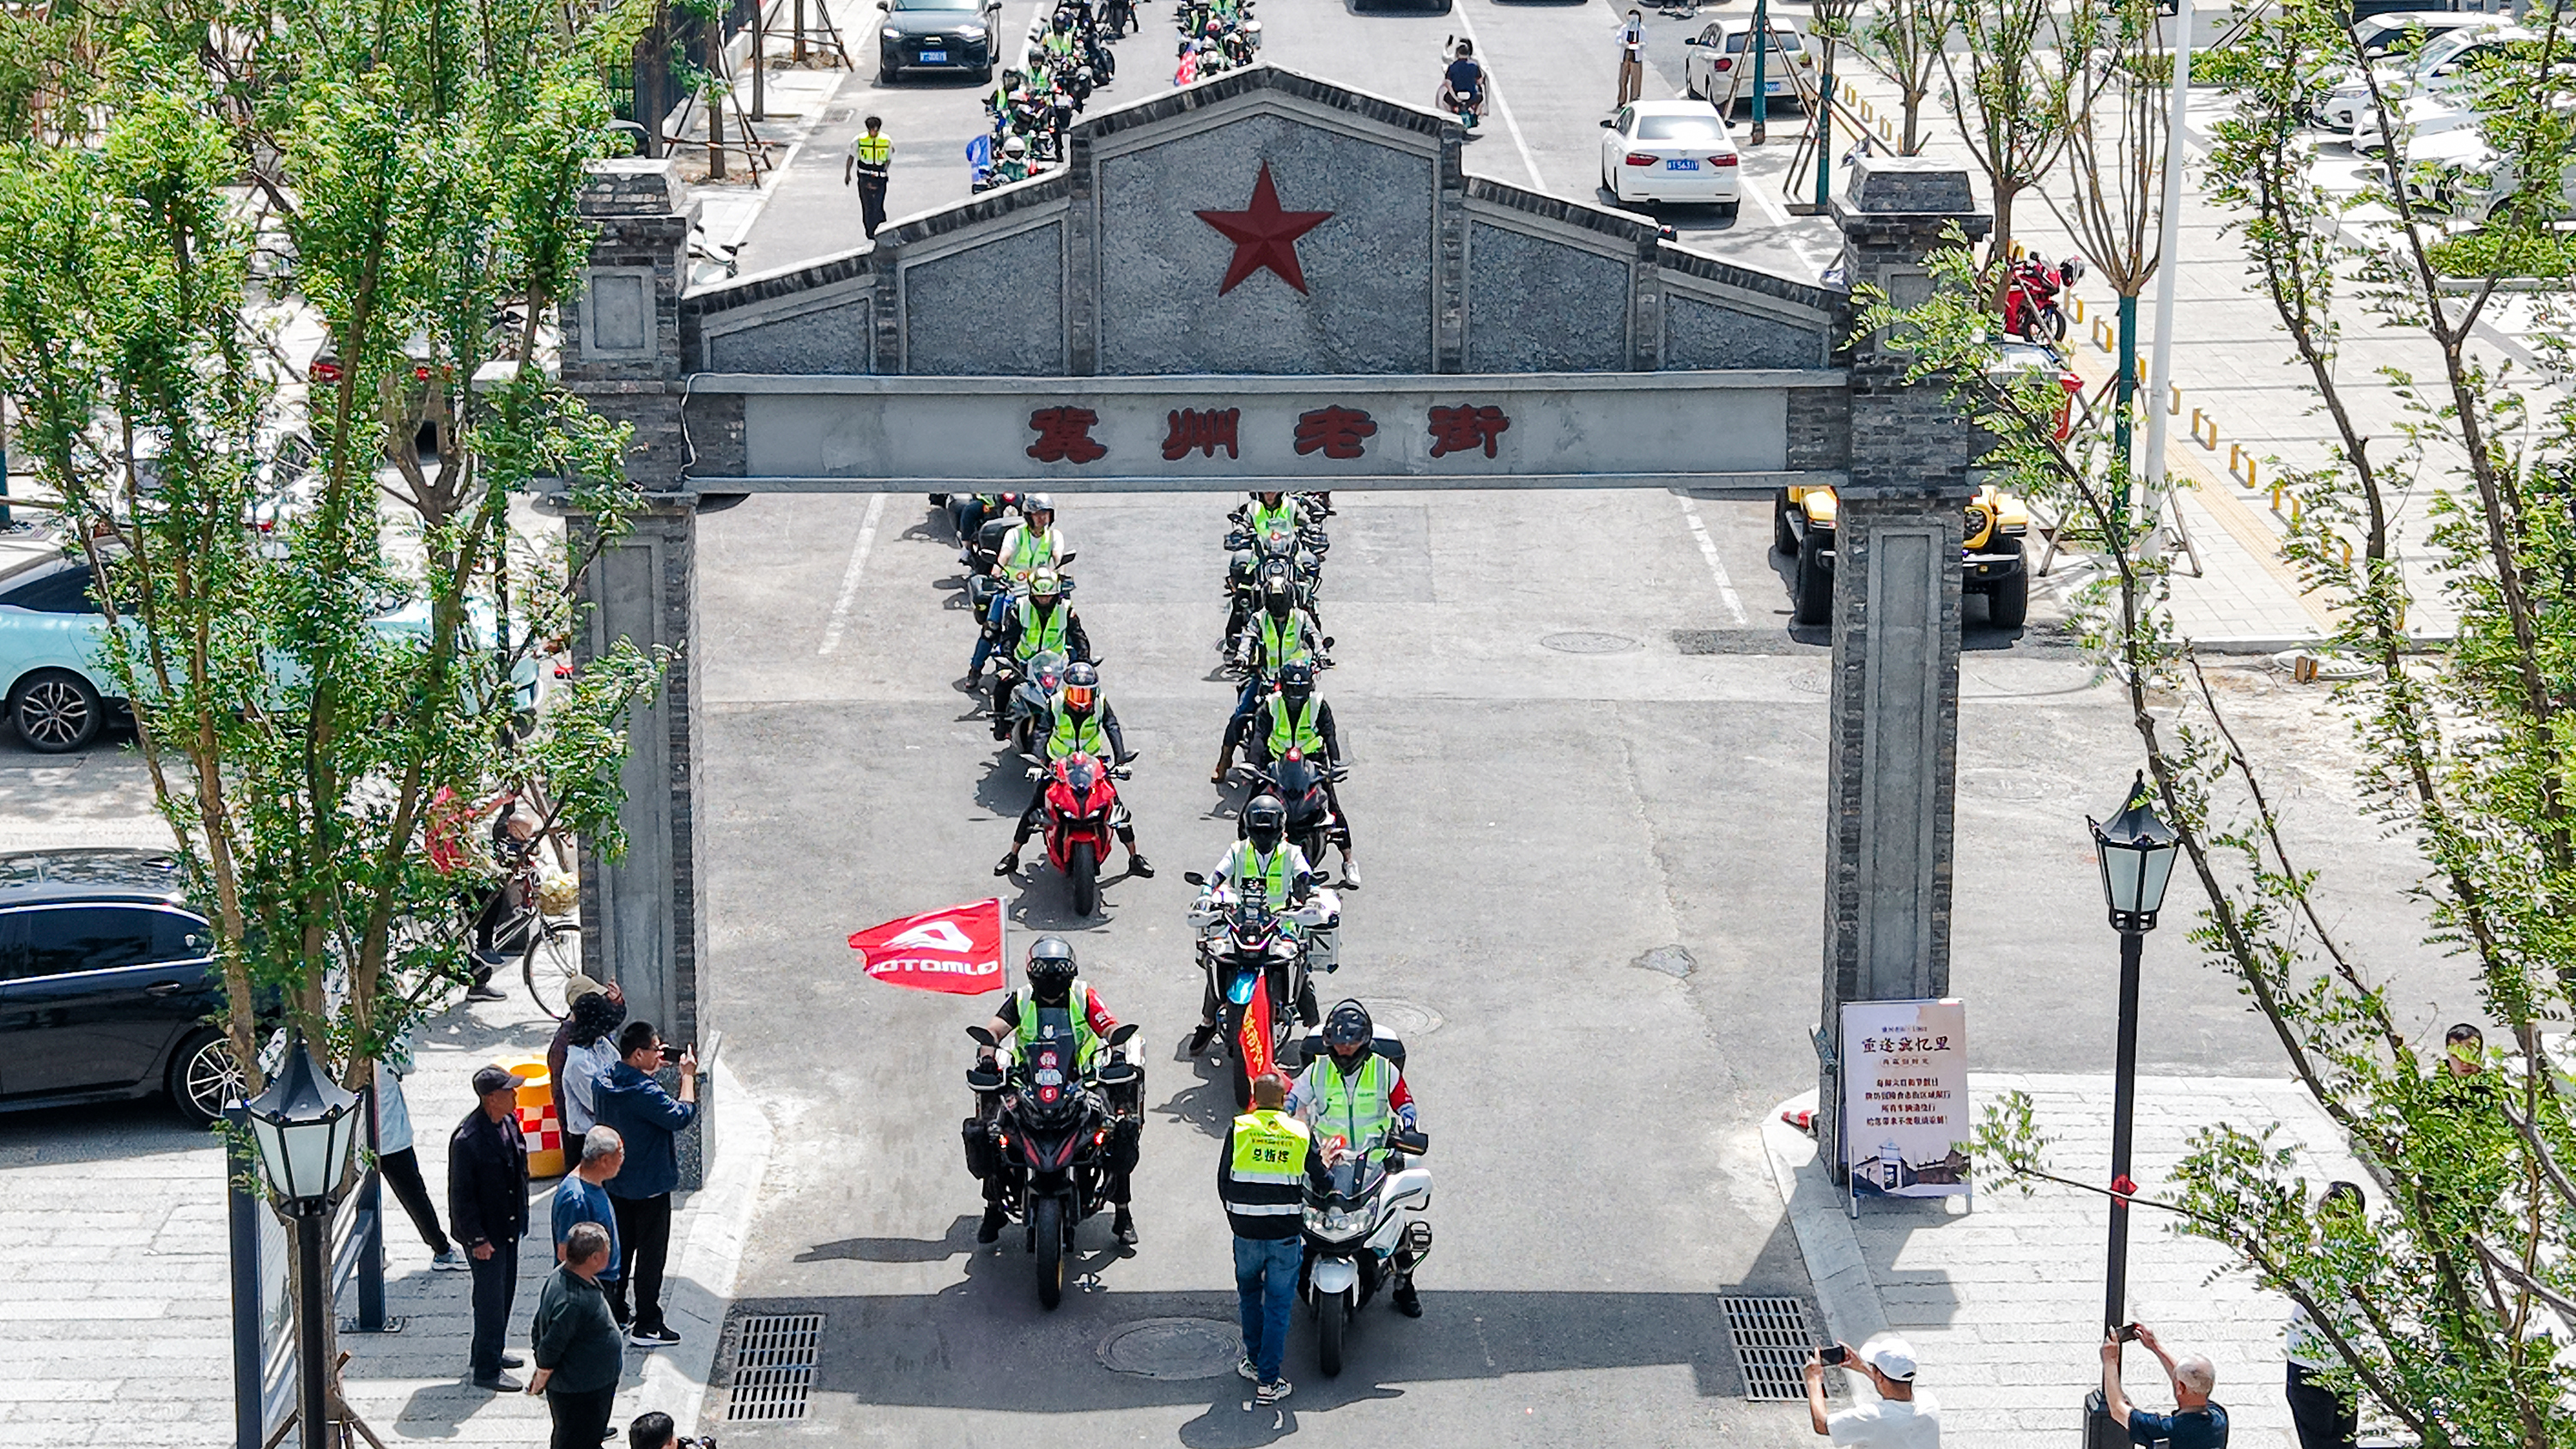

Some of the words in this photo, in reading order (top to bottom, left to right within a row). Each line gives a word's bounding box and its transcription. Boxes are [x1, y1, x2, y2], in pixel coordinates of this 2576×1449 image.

[1026, 404, 1510, 464] 冀州老街
[1252, 1148, 1290, 1163] 总指挥
